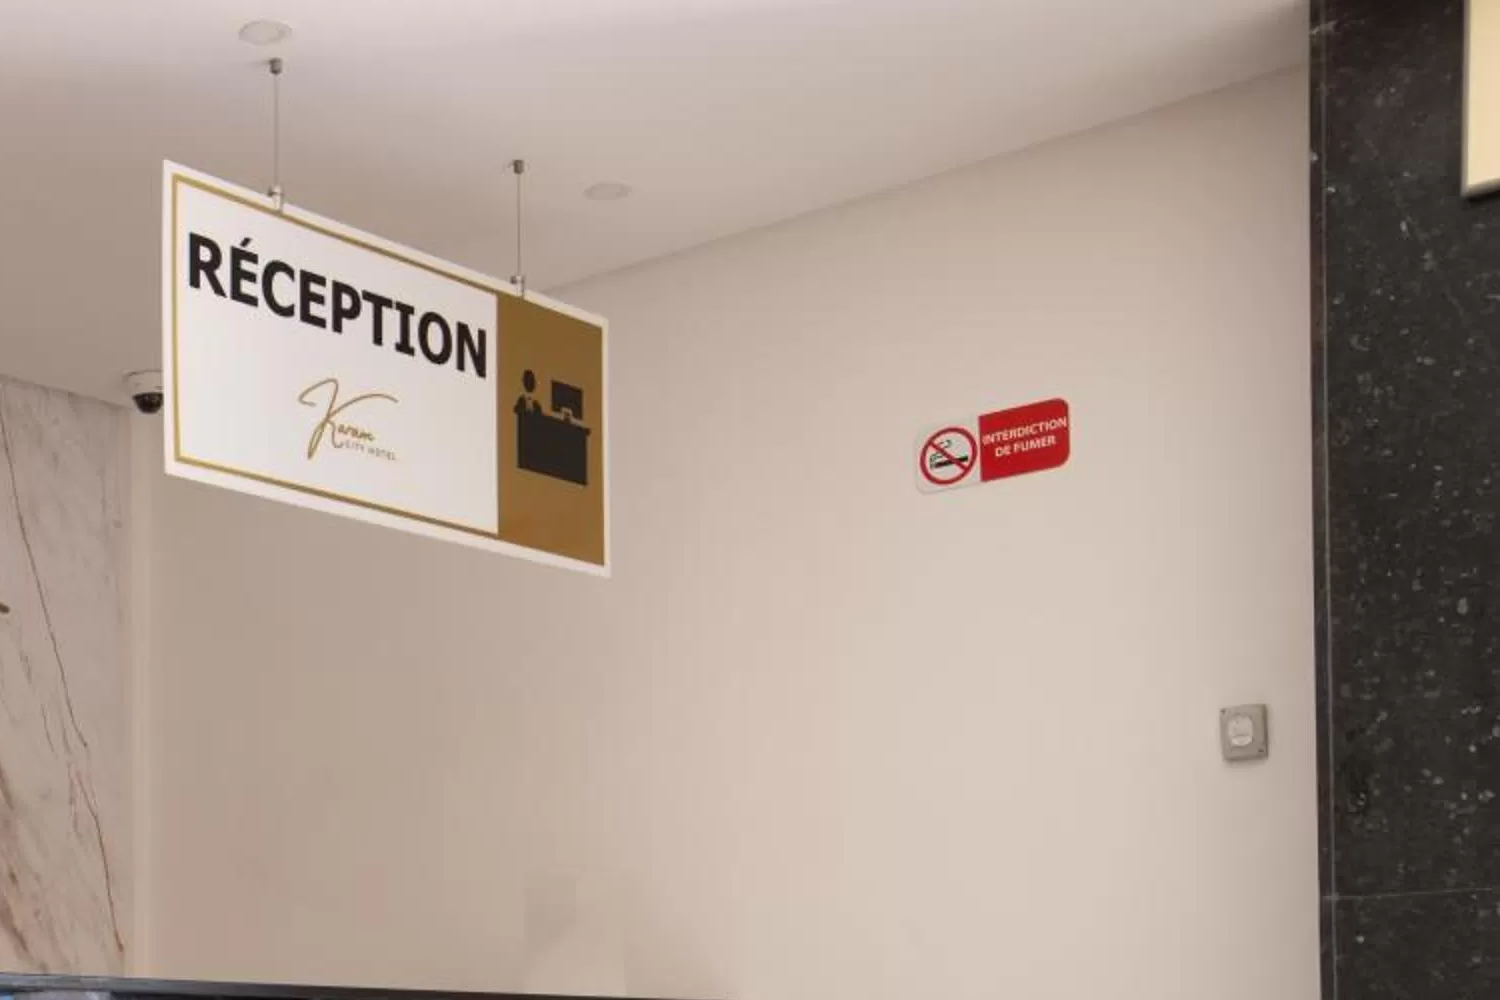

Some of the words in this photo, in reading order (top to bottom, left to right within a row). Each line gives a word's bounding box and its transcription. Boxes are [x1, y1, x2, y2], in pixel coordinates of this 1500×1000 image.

[188, 232, 487, 379] RÉCEPTION
[298, 377, 399, 460] Karam
[982, 416, 1067, 446] INTERDICTION
[995, 446, 1012, 457] DE
[1013, 435, 1056, 453] FUMER
